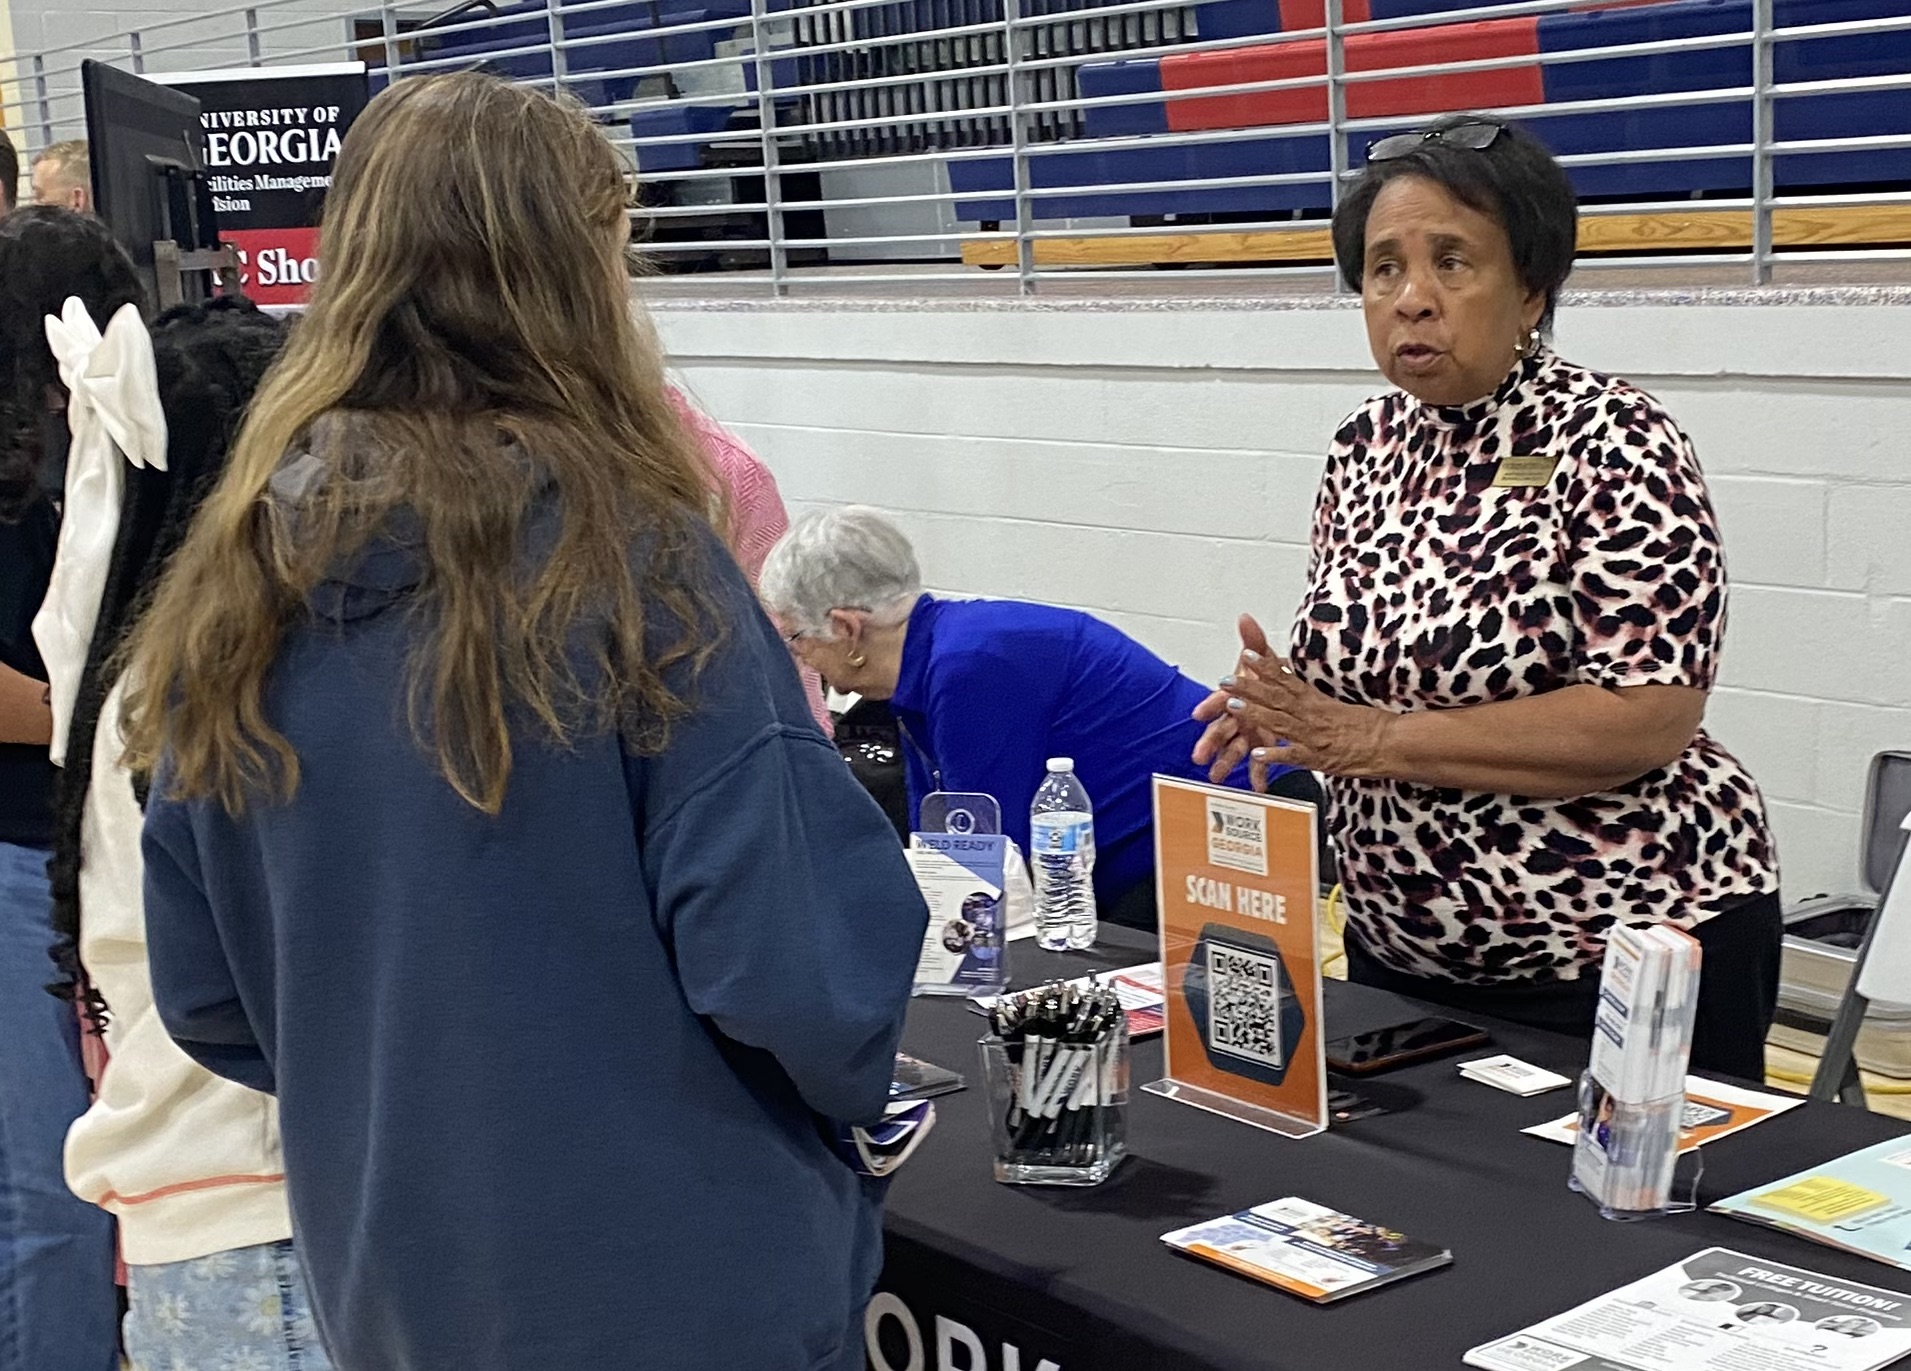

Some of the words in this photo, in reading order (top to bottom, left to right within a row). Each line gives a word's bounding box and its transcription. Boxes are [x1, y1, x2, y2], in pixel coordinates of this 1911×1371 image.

[313, 106, 340, 123] OF
[202, 128, 341, 166] EORGIA
[257, 248, 320, 285] Sho
[953, 840, 995, 851] READY
[1211, 837, 1263, 858] GEORGIA
[1186, 875, 1232, 912] SCAN
[1236, 886, 1287, 925] HERE
[1737, 1266, 1797, 1288] FREE
[1796, 1279, 1902, 1312] TUITION!
